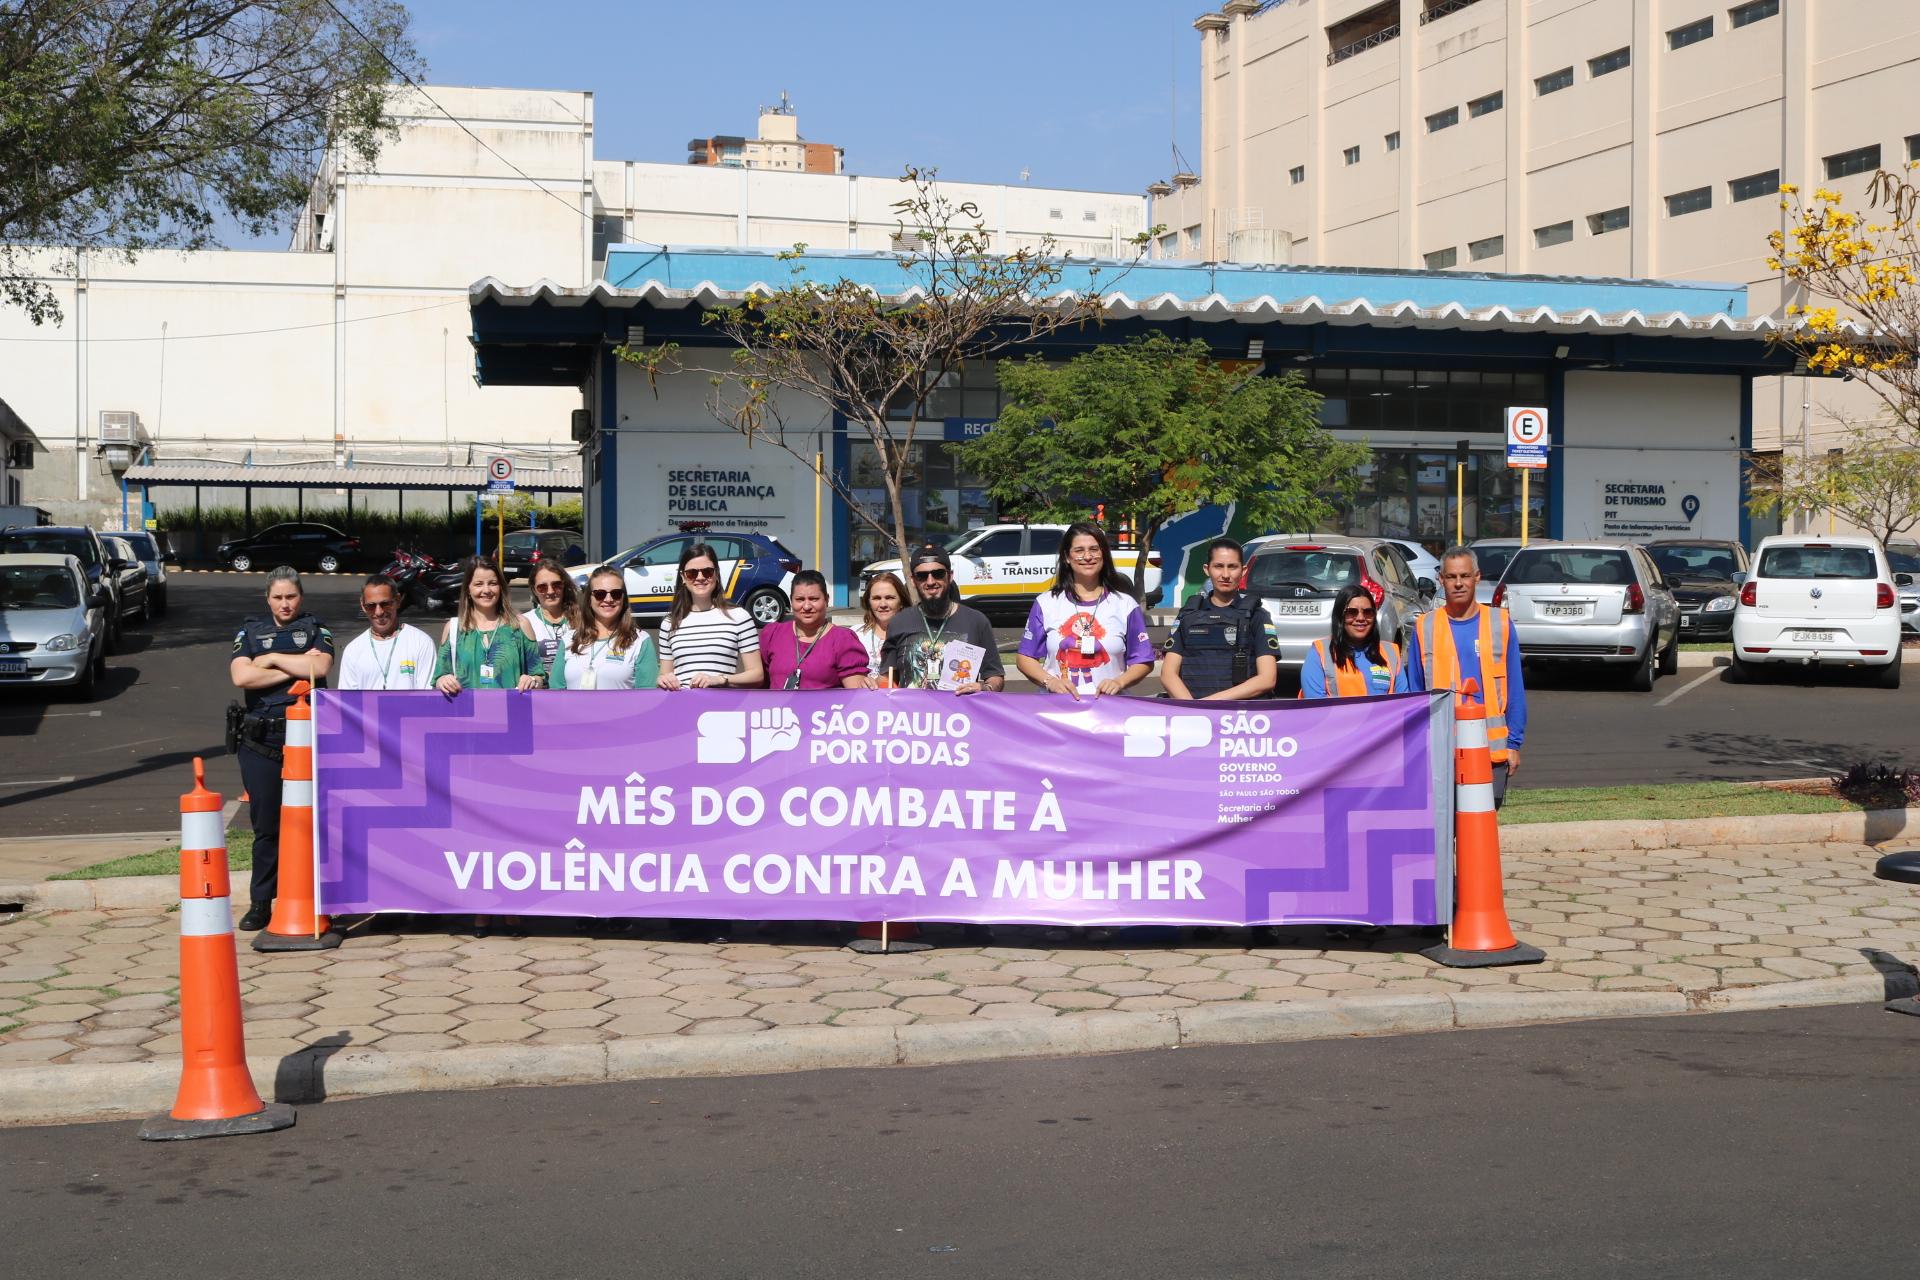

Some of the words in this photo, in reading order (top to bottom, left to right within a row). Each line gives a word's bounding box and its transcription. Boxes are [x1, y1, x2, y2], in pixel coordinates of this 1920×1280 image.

[1522, 418, 1532, 435] E
[497, 463, 504, 474] E
[668, 470, 751, 482] SECRETARIA
[668, 485, 687, 497] DE
[690, 485, 775, 500] SEGURANÇA
[1605, 484, 1665, 494] SECRETARIA
[668, 497, 728, 512] PÚBLICA
[1605, 496, 1619, 505] DE
[1621, 496, 1666, 506] TURISMO
[1605, 511, 1618, 519] PIT
[737, 519, 768, 528] Trânsito
[651, 585, 676, 593] GUA
[811, 704, 869, 736] SÃO
[877, 711, 971, 737] PAULO
[1220, 710, 1271, 735] SÃO
[1220, 737, 1298, 757] PAULO
[811, 740, 868, 764] POR
[872, 740, 970, 766] TODAS
[1219, 763, 1276, 771] GOVERNO
[1219, 774, 1236, 782] DO
[1240, 774, 1282, 782] ESTADO
[576, 771, 676, 826] MÊS
[691, 786, 765, 826] DO
[779, 786, 1016, 831] COMBATE
[1029, 777, 1067, 832] À
[1218, 803, 1262, 812] Secretaria
[1264, 802, 1276, 811] da
[1218, 815, 1254, 824] Mulher
[444, 837, 709, 893] VIOLÊNCIA
[723, 854, 927, 896] CONTRA
[939, 857, 978, 898] A
[992, 860, 1206, 900] MULHER
